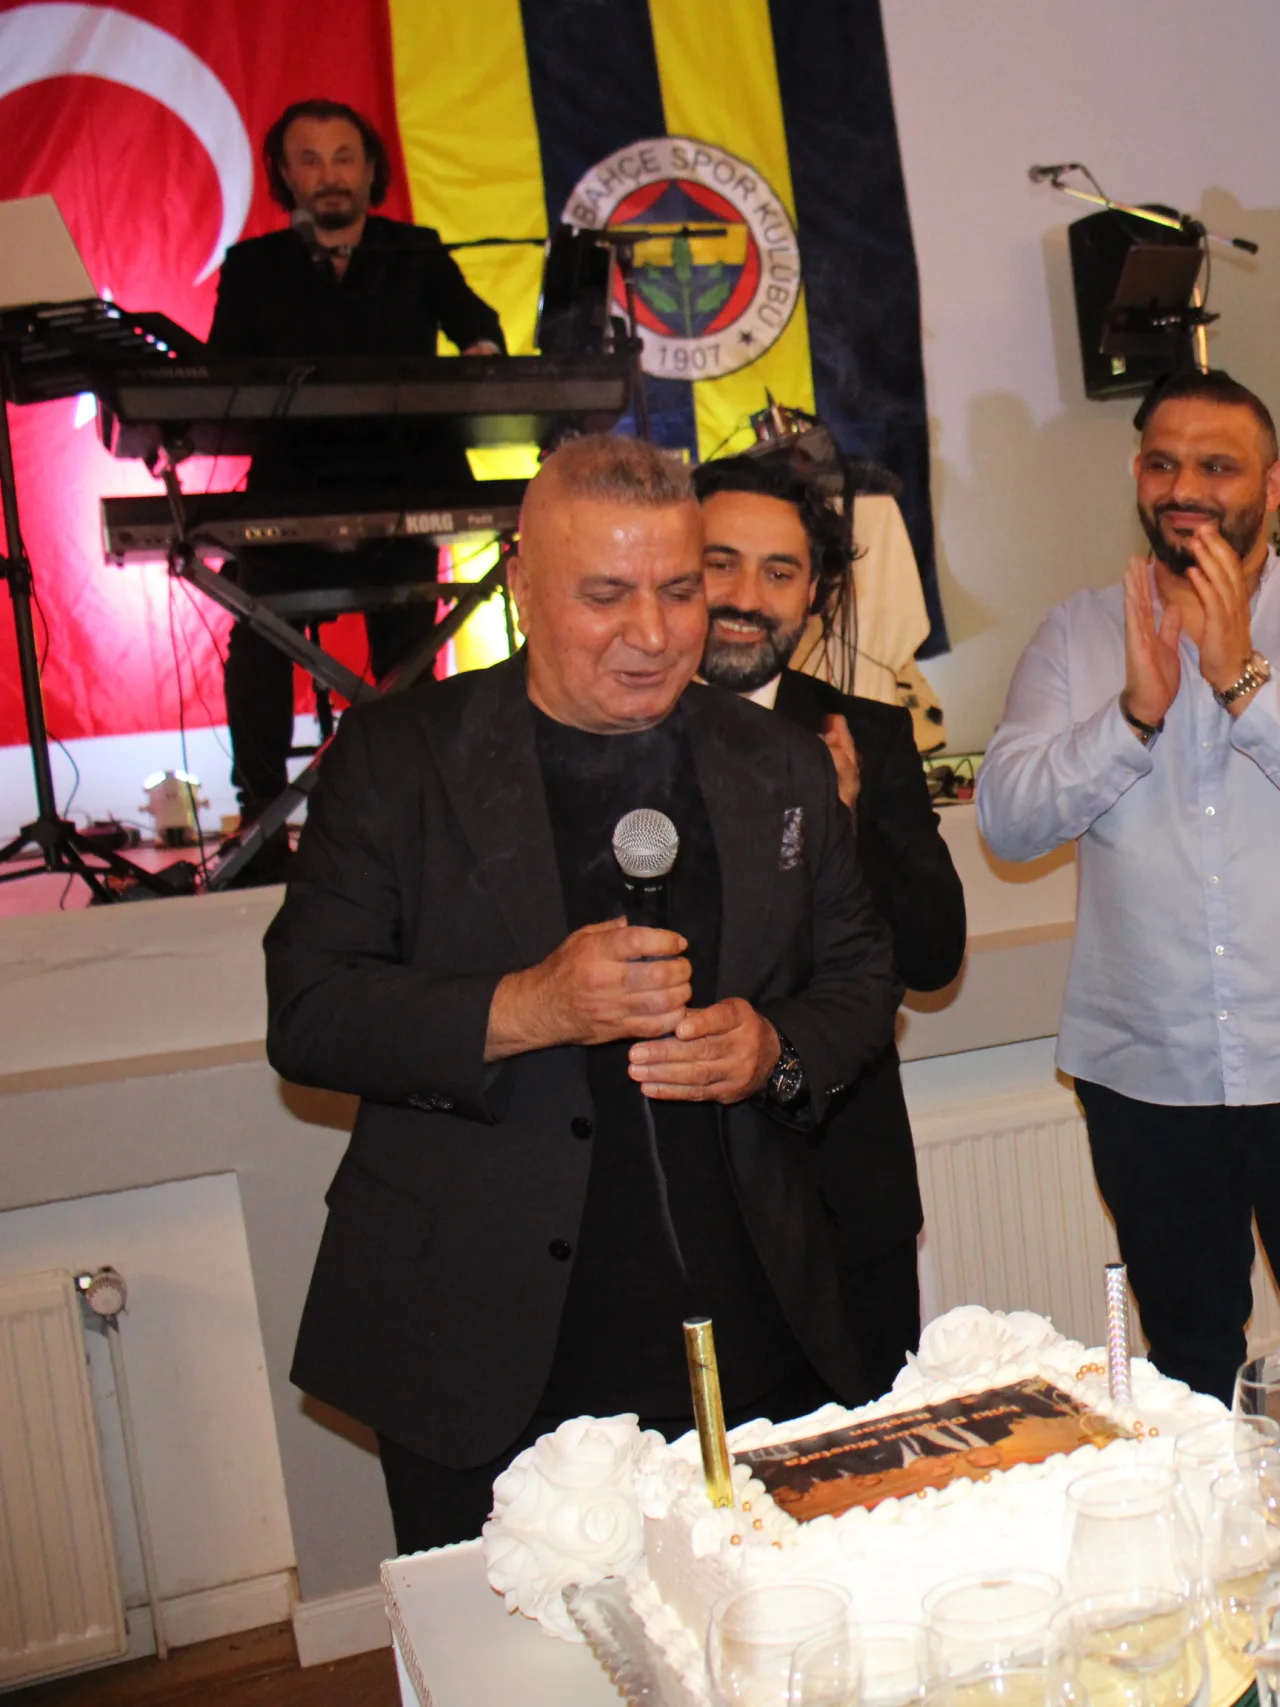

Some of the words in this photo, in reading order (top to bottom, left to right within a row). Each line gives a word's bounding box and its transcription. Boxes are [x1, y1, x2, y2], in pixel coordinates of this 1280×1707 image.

[573, 147, 661, 226] BAHÇE
[672, 147, 757, 199] SPOR
[658, 344, 721, 370] 1907
[405, 513, 454, 533] KORG
